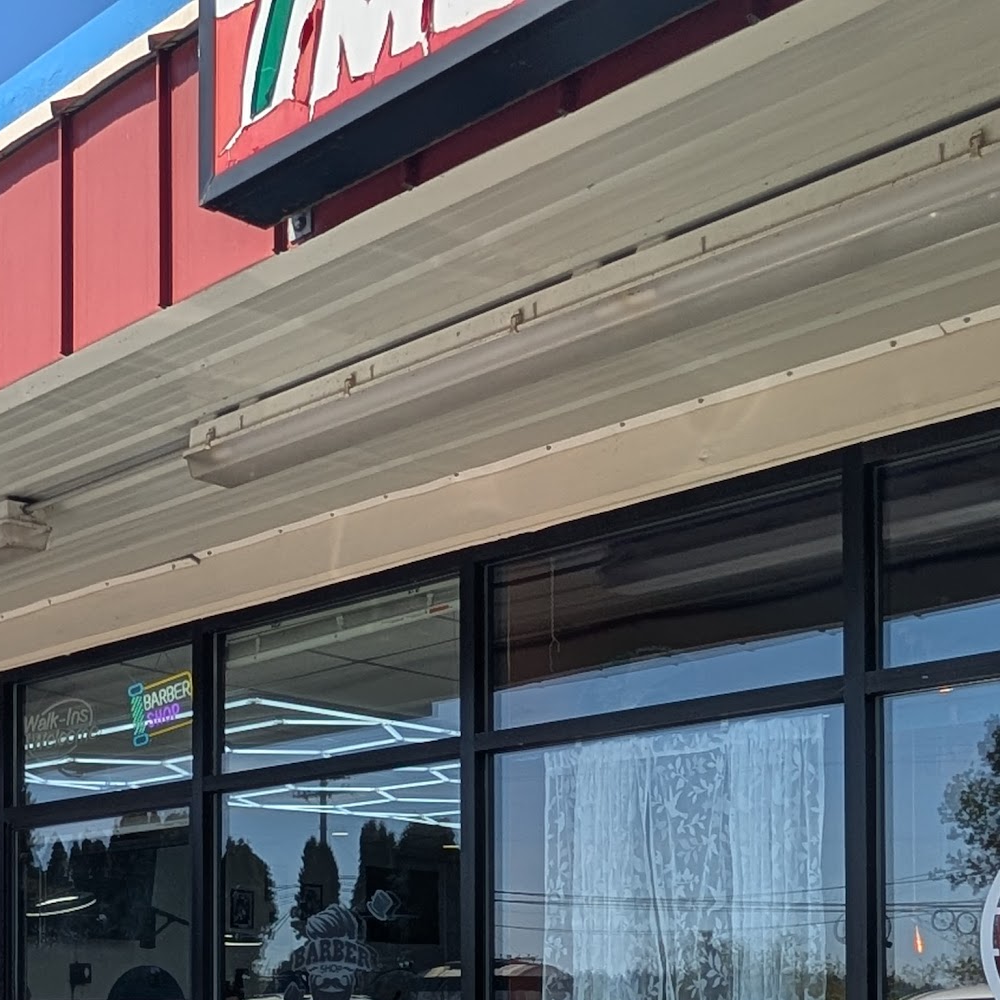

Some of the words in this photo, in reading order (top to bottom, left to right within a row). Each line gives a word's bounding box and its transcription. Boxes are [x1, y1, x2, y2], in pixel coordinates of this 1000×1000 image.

[143, 681, 191, 711] BARBER
[24, 707, 90, 734] Walk-Ins
[146, 703, 180, 728] SHOP
[291, 938, 372, 971] BARBER
[320, 963, 342, 974] SHOP
